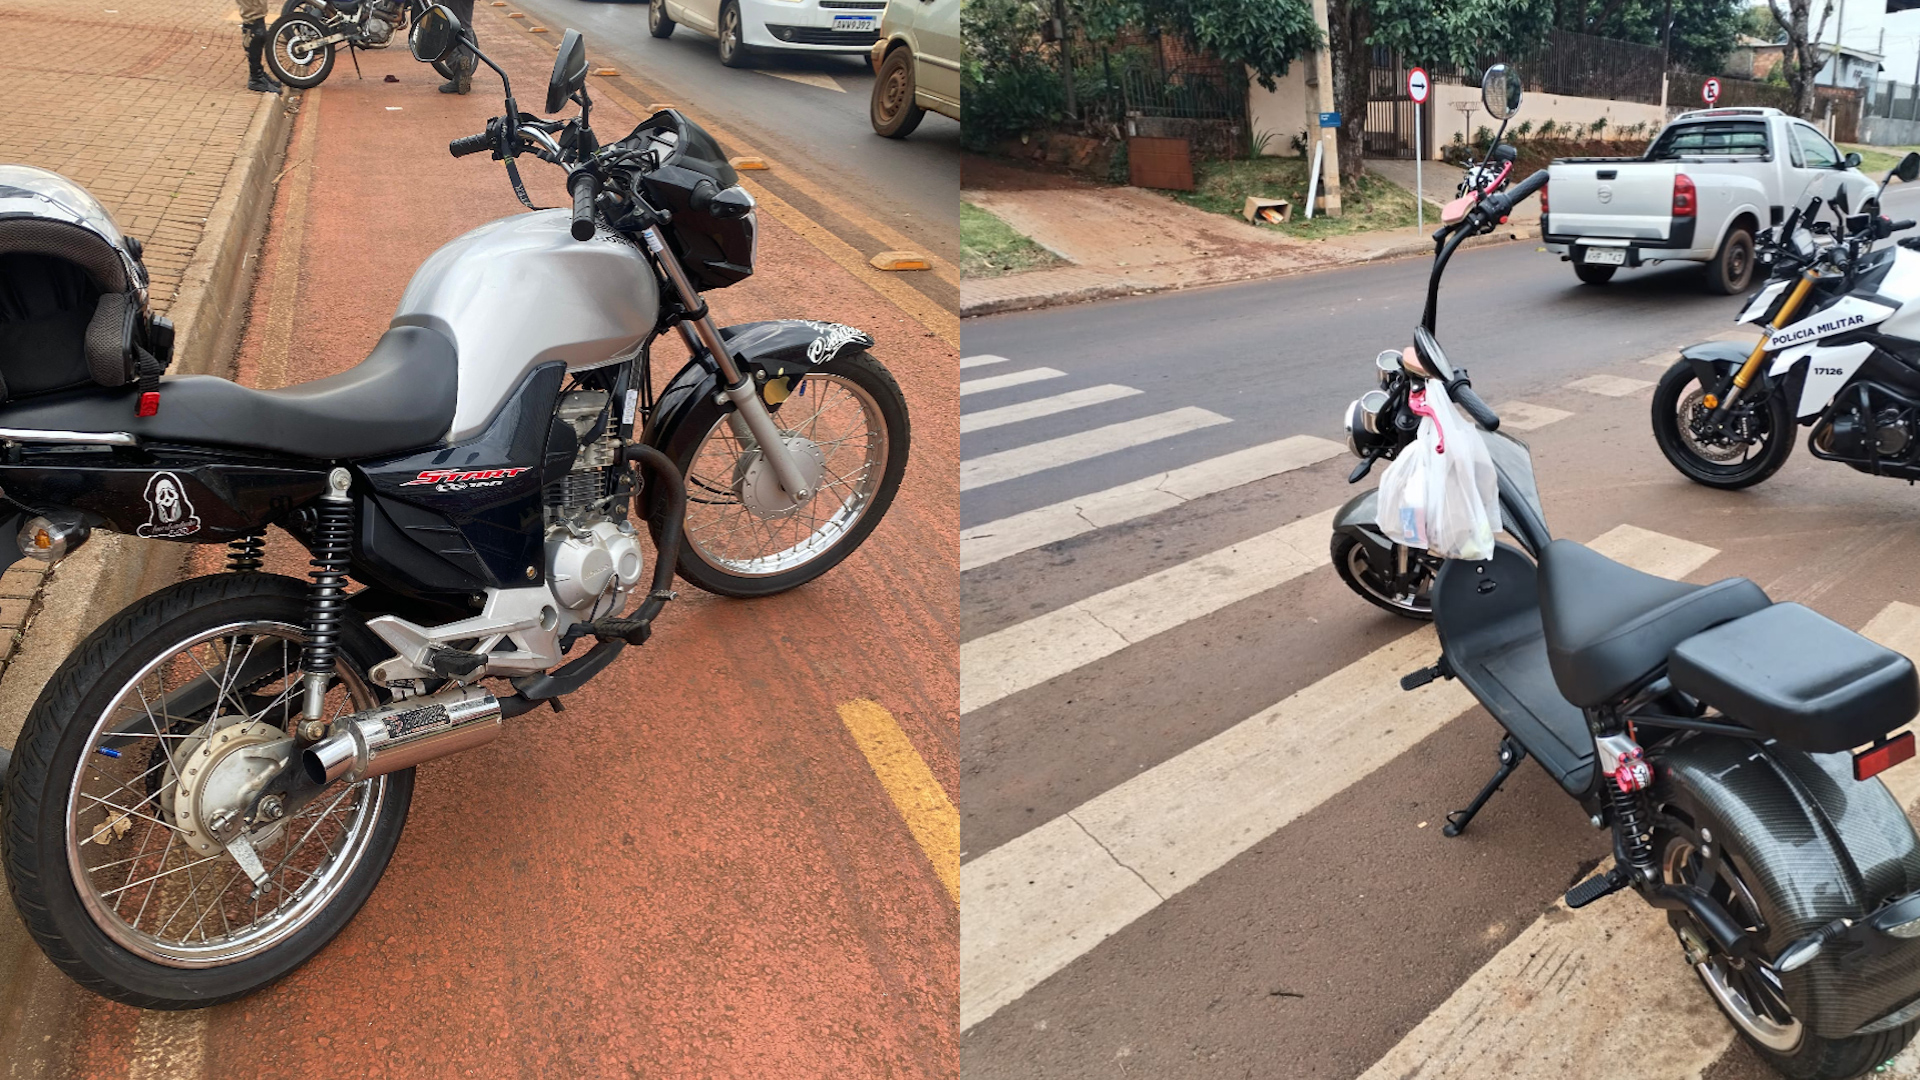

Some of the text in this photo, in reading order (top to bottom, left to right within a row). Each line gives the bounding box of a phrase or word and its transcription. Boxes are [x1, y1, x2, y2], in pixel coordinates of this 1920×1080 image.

[1817, 314, 1865, 334] MILITAR
[1814, 367, 1844, 376] 17126
[399, 466, 534, 487] START
